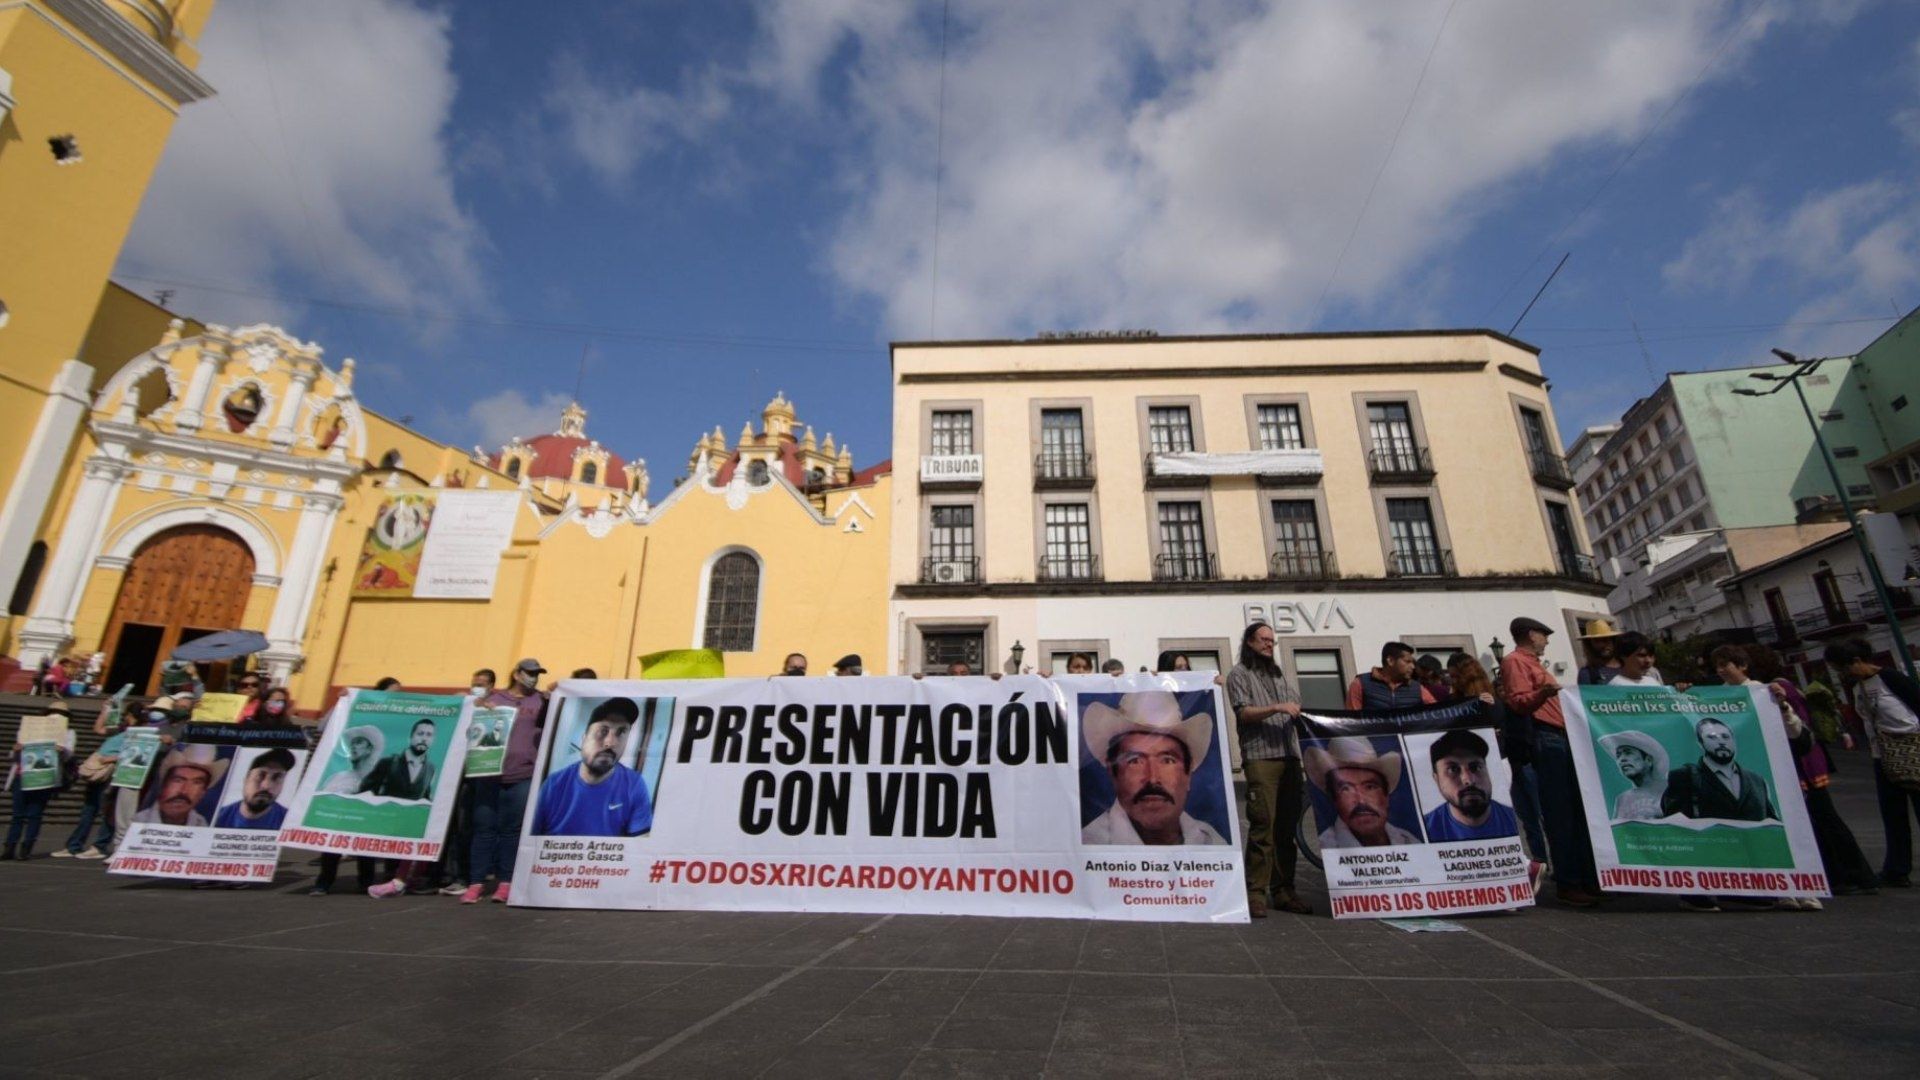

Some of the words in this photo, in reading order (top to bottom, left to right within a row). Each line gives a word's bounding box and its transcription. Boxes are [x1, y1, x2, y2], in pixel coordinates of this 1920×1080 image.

[925, 459, 979, 475] TRIBUNA
[1243, 598, 1355, 633] BBVA
[1591, 702, 1641, 713] ¿quién
[1670, 701, 1747, 713] defiende?
[677, 692, 1069, 766] PRESENTACIÓN
[739, 769, 851, 836] CON
[866, 772, 997, 838] VIDA
[329, 834, 350, 848] LOS
[352, 837, 415, 854] QUEREMOS
[543, 840, 583, 850] Ricardo
[587, 841, 624, 851] Arturo
[1438, 848, 1485, 859] RICARDO
[1487, 843, 1521, 855] ARTURO
[539, 852, 583, 862] Lagunes
[587, 852, 624, 861] Gasca
[1338, 854, 1384, 864] ANTONIO
[1385, 852, 1409, 862] DÍAZ
[1443, 861, 1492, 872] LAGUNES
[1494, 857, 1523, 867] GASCA
[160, 860, 182, 874] LOS
[185, 862, 249, 877] QUEREMOS
[578, 866, 630, 876] Defensor
[1085, 861, 1137, 871] Antonio
[1173, 861, 1233, 871] Valencia
[1351, 867, 1401, 877] VALENCIA
[549, 879, 562, 888] de
[565, 879, 599, 888] DDHH
[649, 860, 1074, 895] #TODOSXRICARDOYANTONIO
[1108, 877, 1164, 888] Maestro
[1168, 880, 1176, 890] y
[1600, 868, 1662, 888] ¡¡VIVOS
[1664, 870, 1694, 888] LOS
[1696, 871, 1789, 890] QUEREMOS
[1790, 873, 1826, 891] YA!!
[1123, 894, 1207, 905] Comunitario
[1333, 892, 1392, 916] ¡¡VIVOS
[1395, 890, 1424, 911] LOS
[1427, 886, 1507, 909] QUEREMOS
[1508, 882, 1532, 902] YA!!
